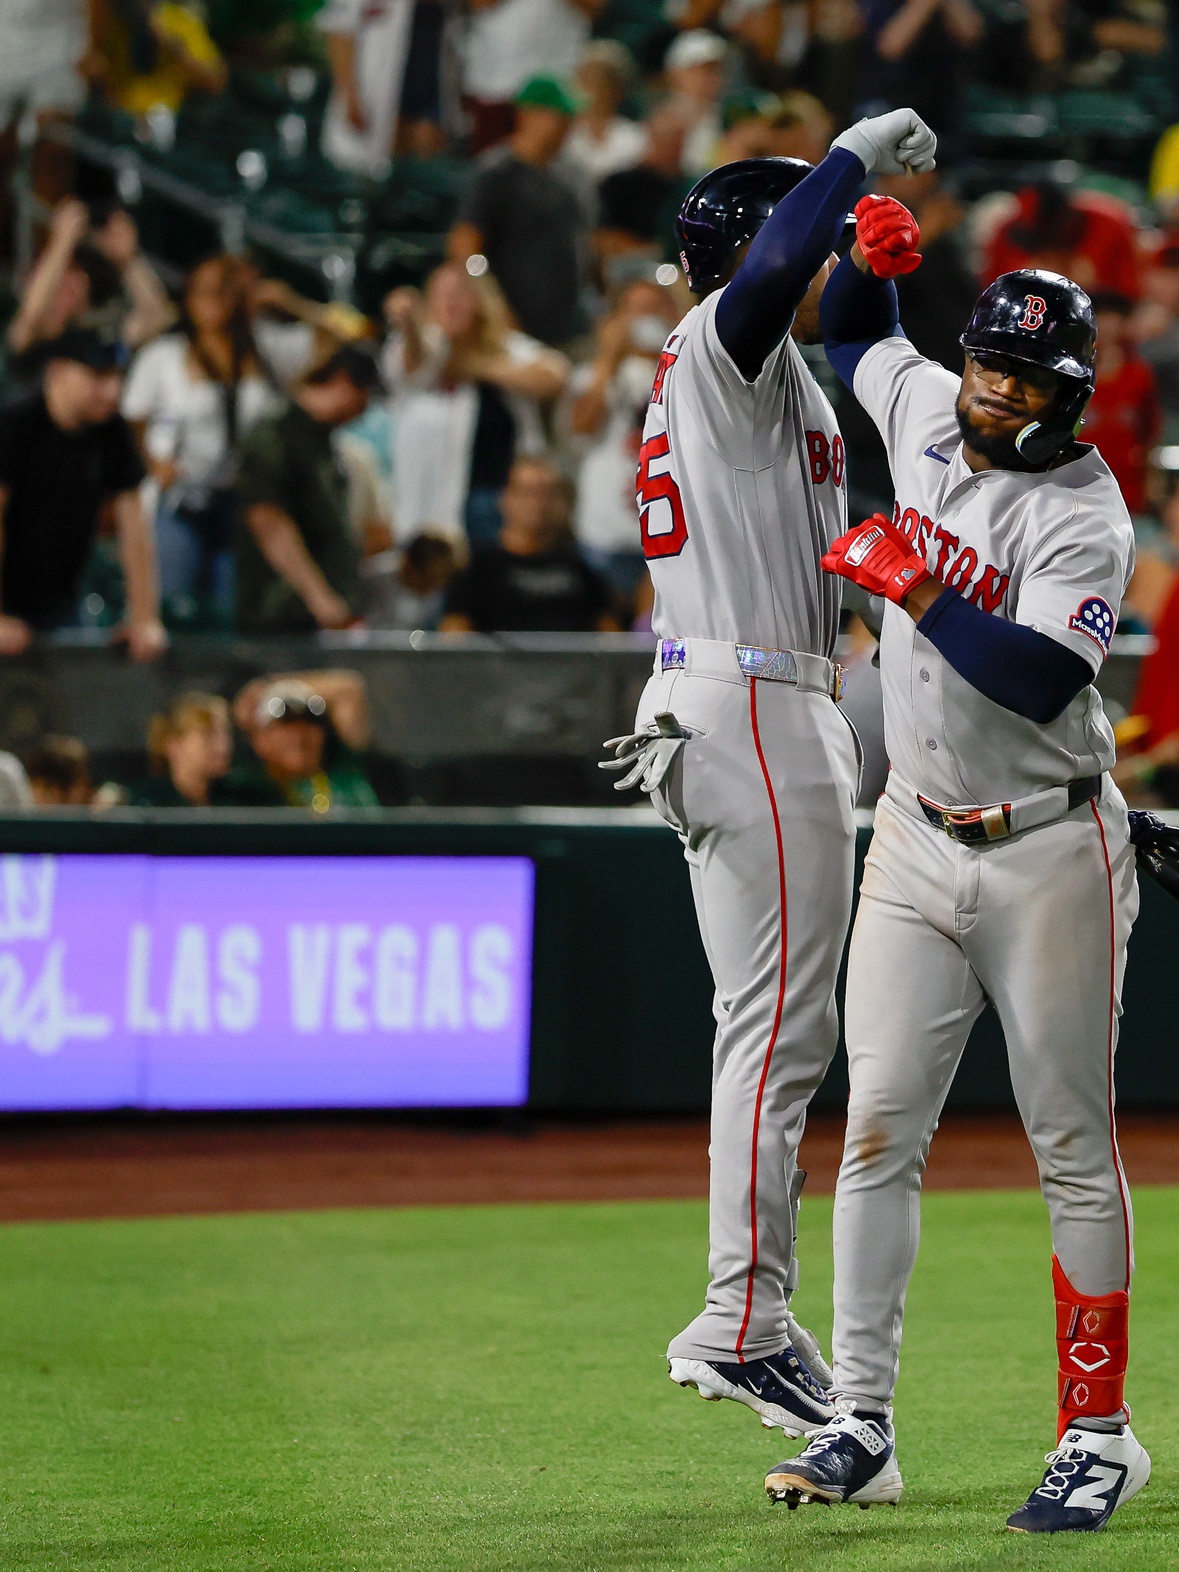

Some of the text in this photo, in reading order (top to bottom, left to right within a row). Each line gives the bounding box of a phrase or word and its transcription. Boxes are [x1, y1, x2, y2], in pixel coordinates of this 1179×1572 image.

[1018, 295, 1047, 330] B
[124, 923, 263, 1034] LAS
[288, 922, 515, 1034] VEGAS
